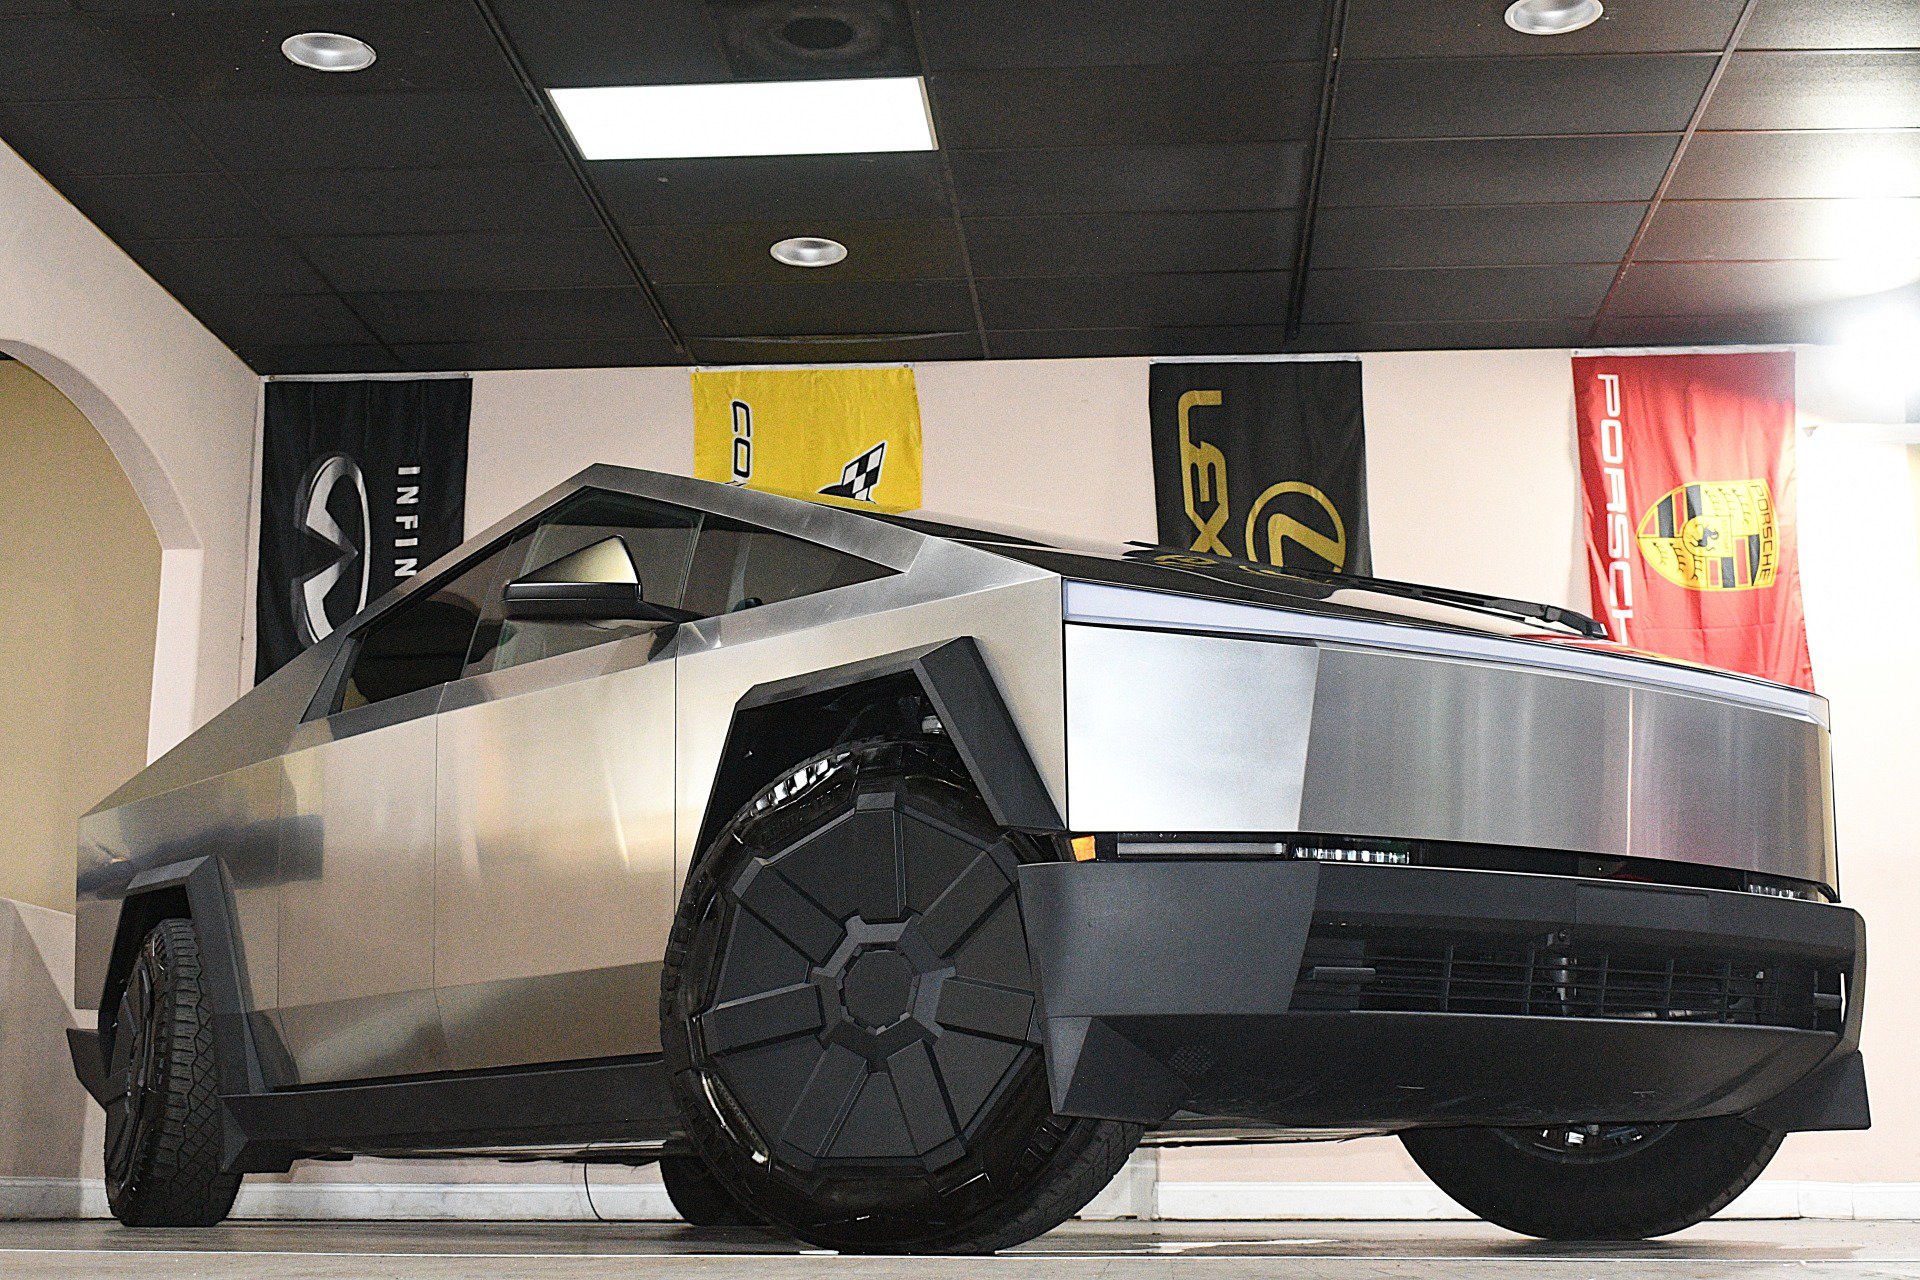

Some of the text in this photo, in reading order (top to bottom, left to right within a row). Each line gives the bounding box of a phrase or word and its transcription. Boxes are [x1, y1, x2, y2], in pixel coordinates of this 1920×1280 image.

[731, 400, 752, 487] CO
[394, 465, 421, 577] INFIN
[1750, 485, 1774, 581] PORSCHE
